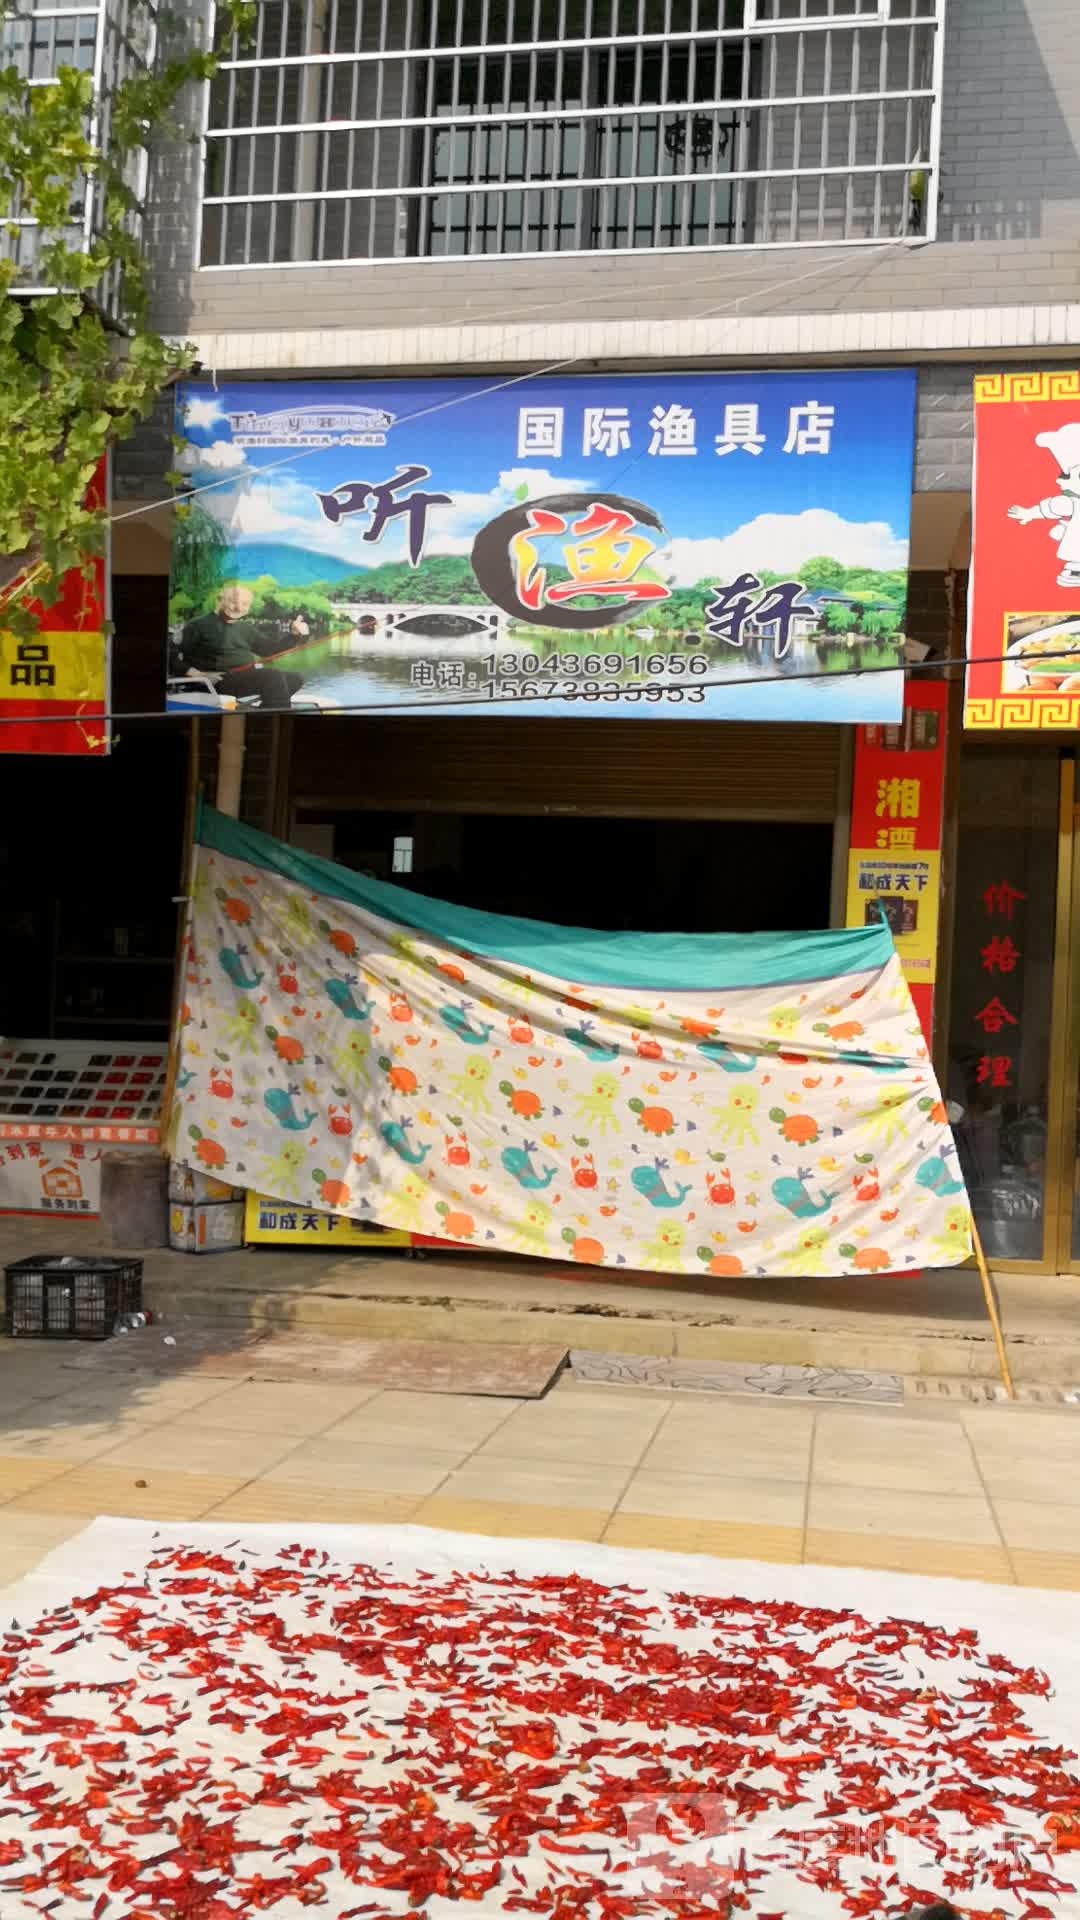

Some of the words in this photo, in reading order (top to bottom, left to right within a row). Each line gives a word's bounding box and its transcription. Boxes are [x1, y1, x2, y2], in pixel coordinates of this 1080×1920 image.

[516, 400, 836, 459] 国际渔具店
[316, 463, 817, 660] 听渔轩
[10, 645, 55, 686] 品
[482, 653, 708, 676] 13043691656
[481, 680, 706, 703] 15673835953
[974, 880, 1026, 1088] 价格合理
